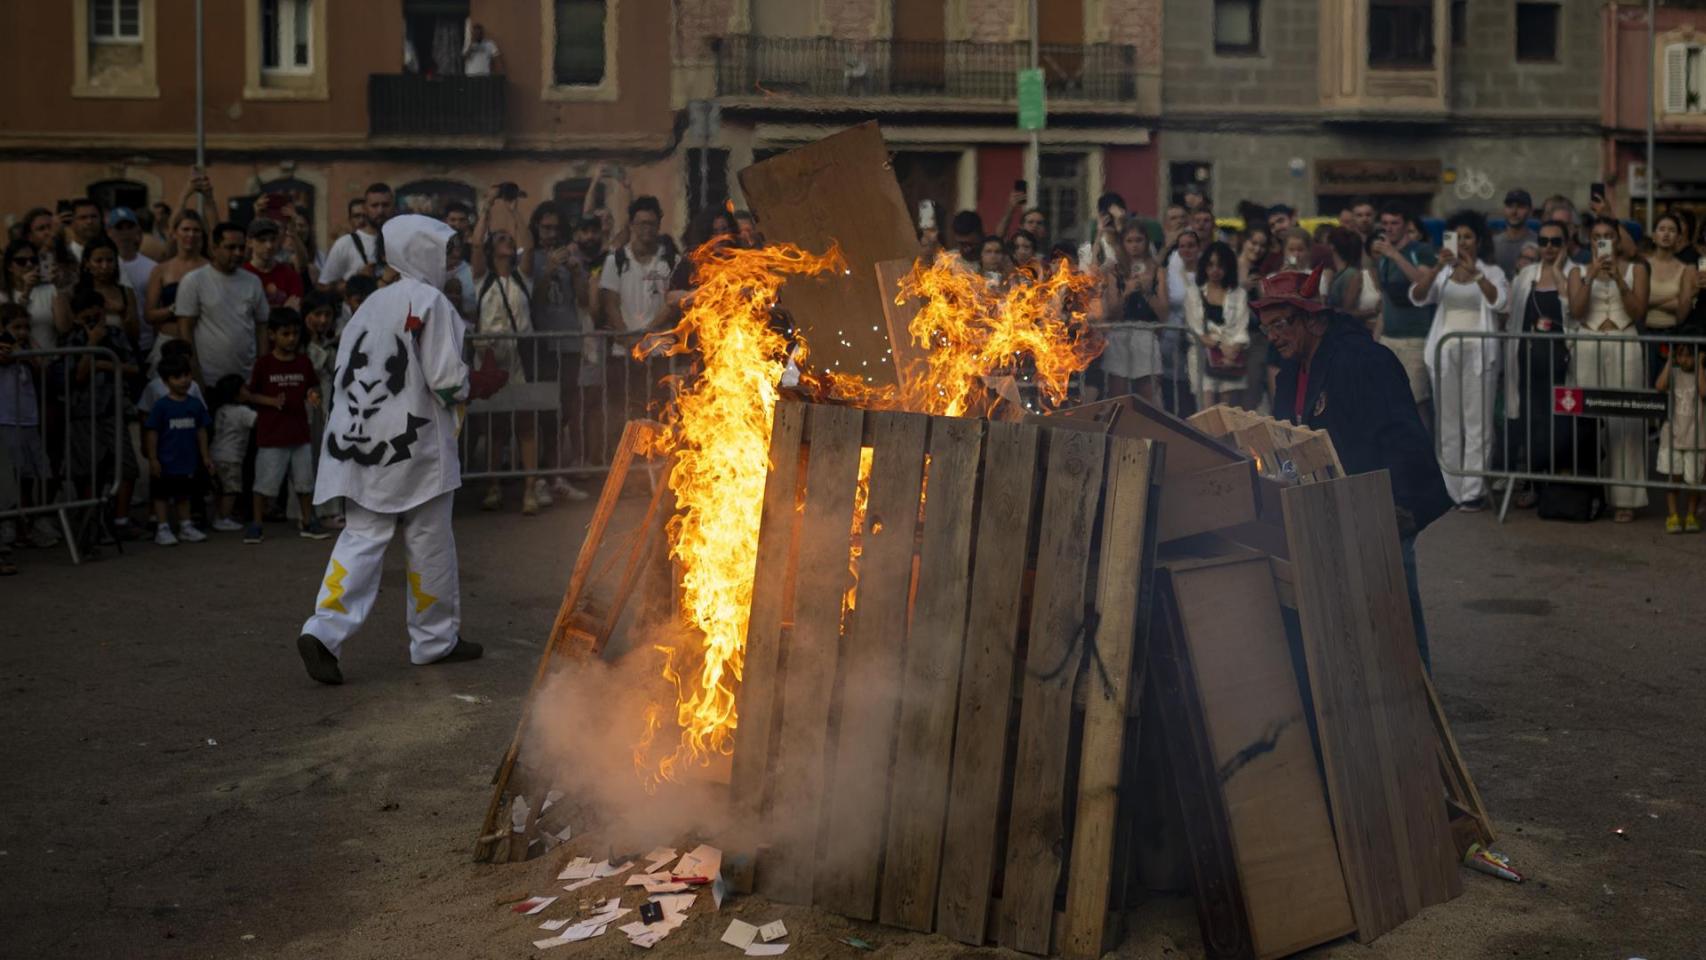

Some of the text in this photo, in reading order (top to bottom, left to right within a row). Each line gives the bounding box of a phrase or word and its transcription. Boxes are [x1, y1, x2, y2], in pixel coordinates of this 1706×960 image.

[1585, 398, 1666, 410] Ajuntament de Barcelona
